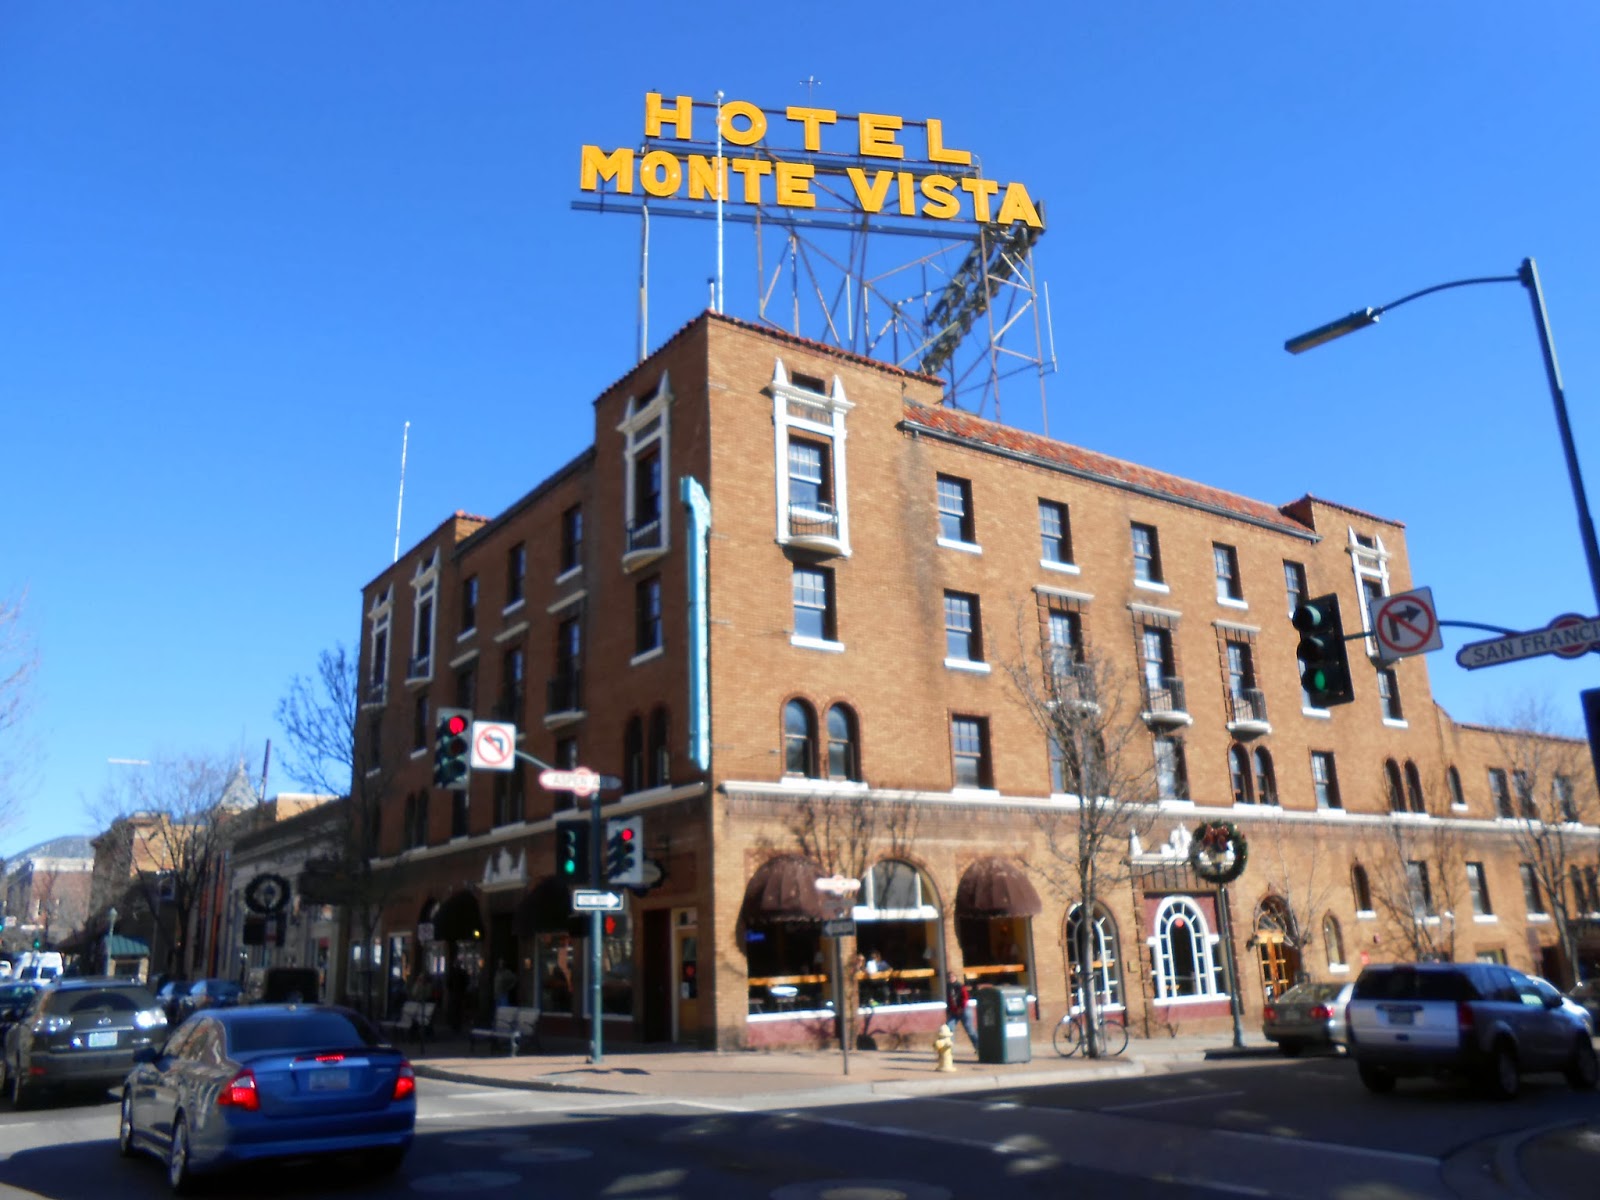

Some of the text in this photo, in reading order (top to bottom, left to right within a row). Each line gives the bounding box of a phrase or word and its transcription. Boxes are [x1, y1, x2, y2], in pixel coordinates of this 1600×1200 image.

[645, 92, 971, 165] HOTEL
[581, 145, 1044, 228] MONTE VISTA
[1473, 622, 1600, 663] SAN FRANCI
